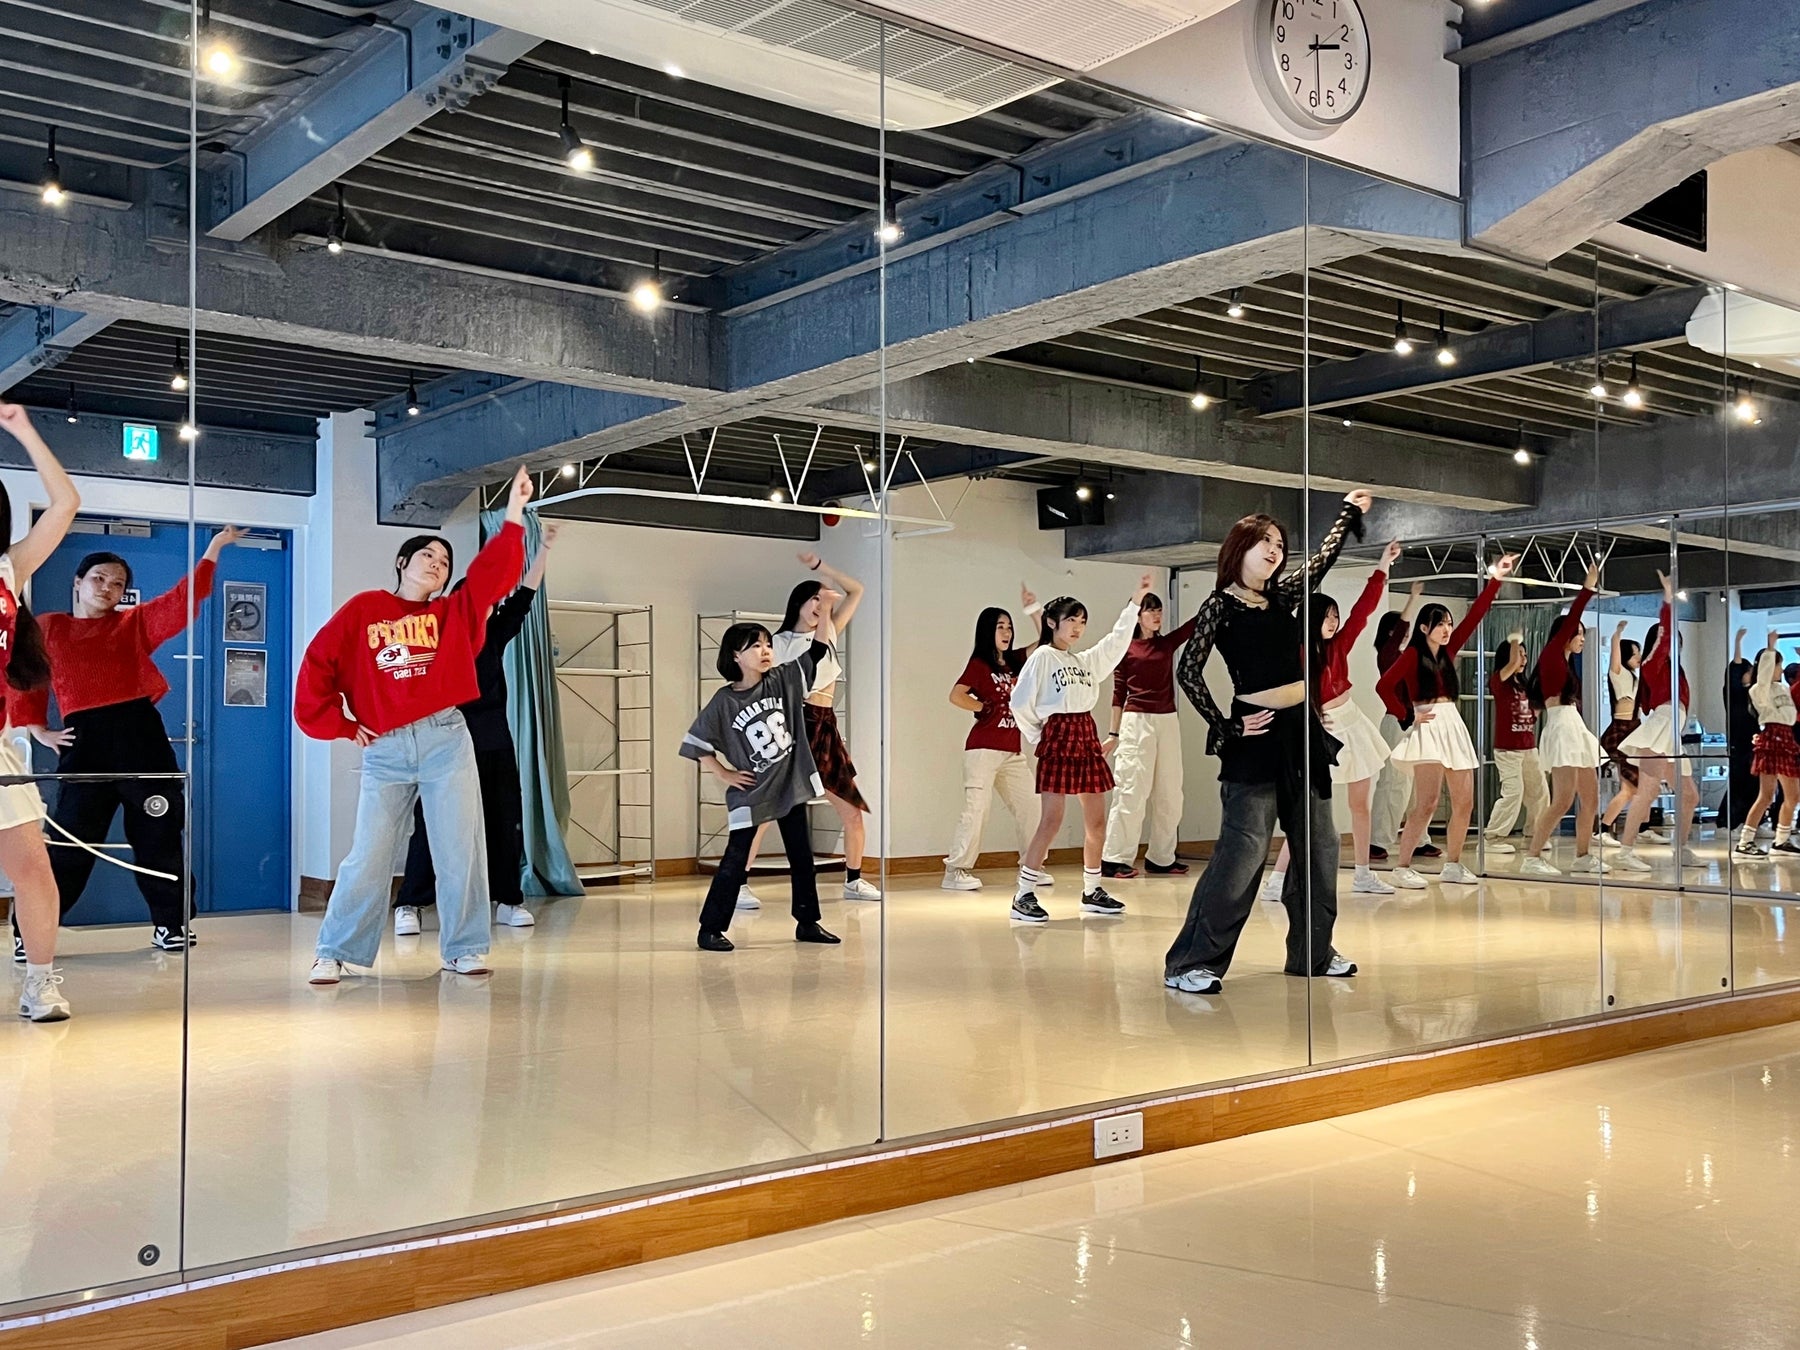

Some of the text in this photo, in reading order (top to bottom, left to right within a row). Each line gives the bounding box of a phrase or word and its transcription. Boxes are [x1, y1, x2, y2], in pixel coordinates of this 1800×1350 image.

[1282, 0, 1294, 20] 10
[1277, 25, 1286, 43] 9
[1340, 24, 1349, 42] 2
[1281, 54, 1290, 71] 8
[1344, 53, 1353, 70] 3
[1294, 77, 1302, 94] 7
[1338, 78, 1347, 94] 4
[1309, 90, 1318, 107] 6
[1326, 90, 1335, 107] 5
